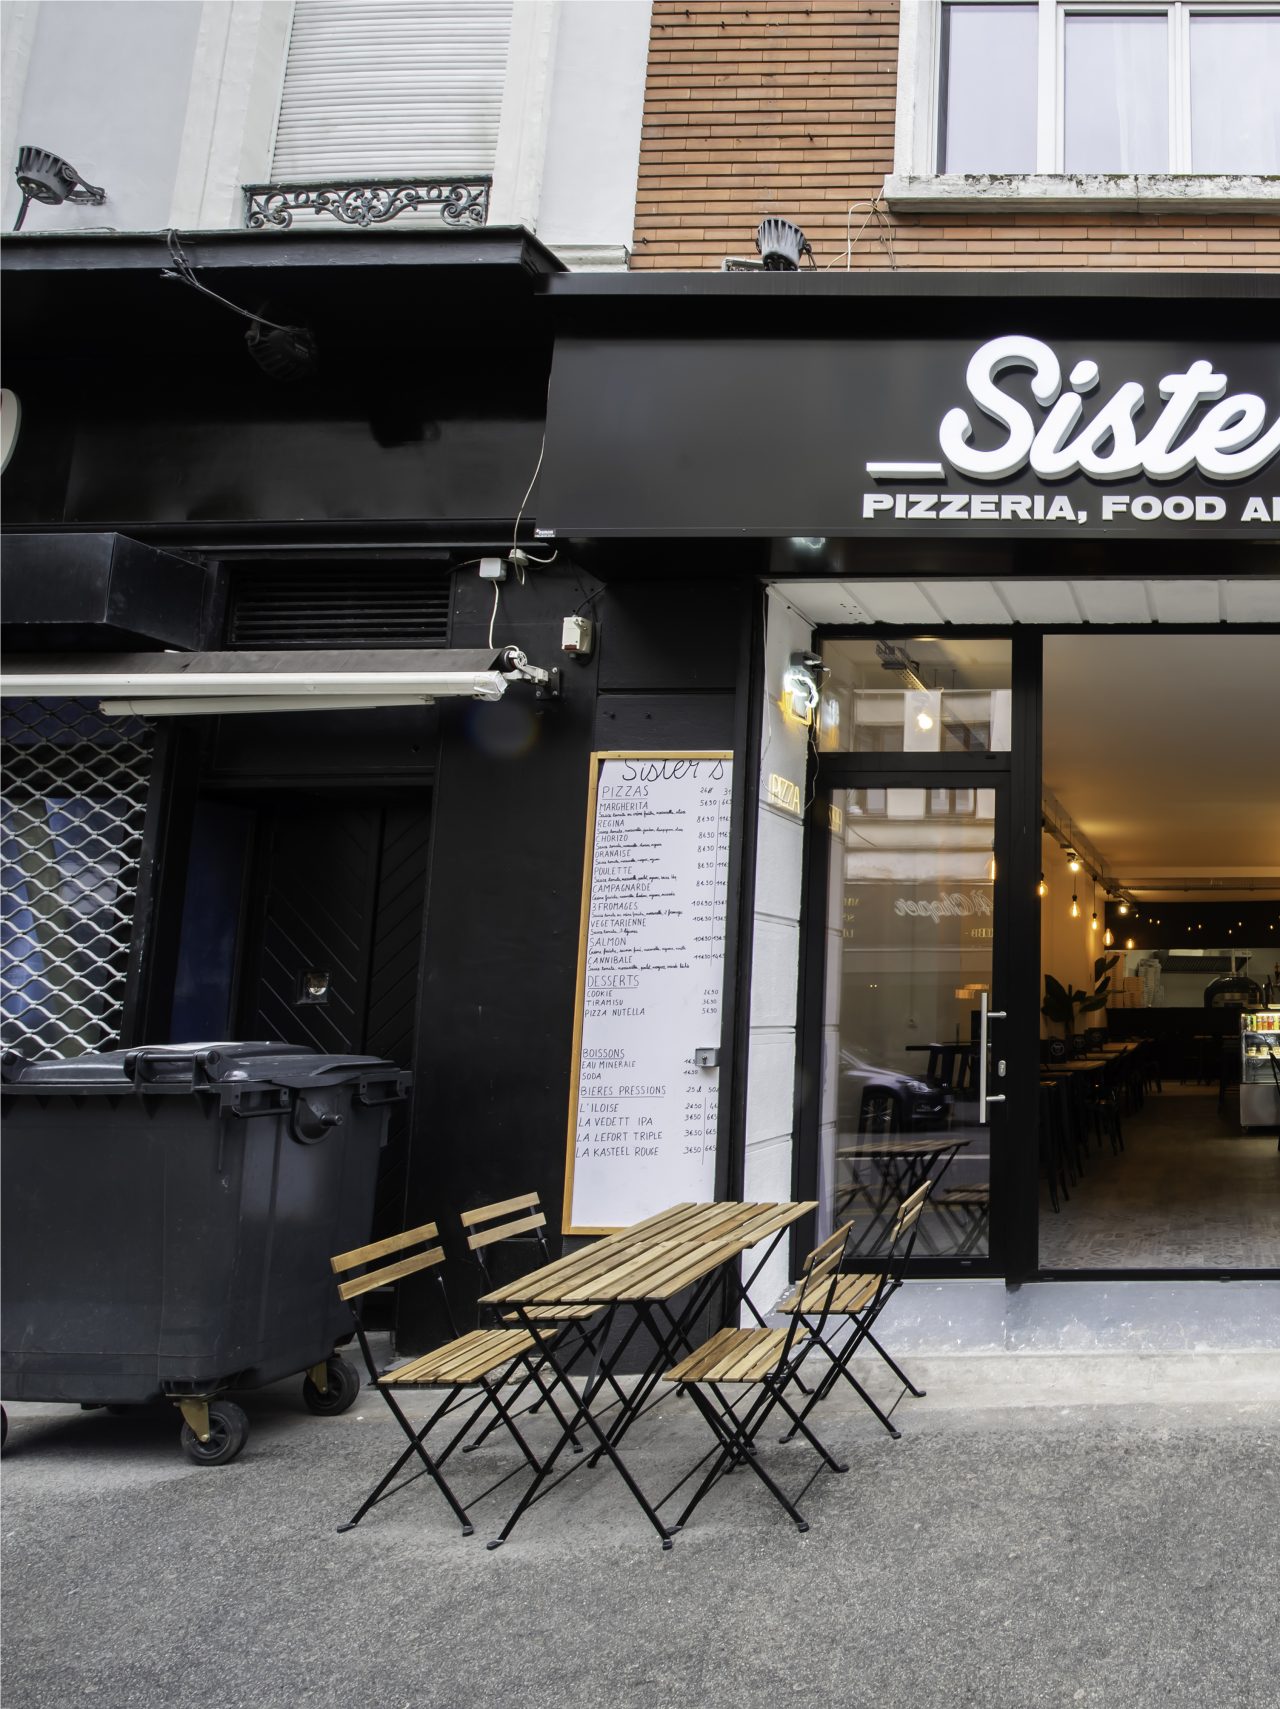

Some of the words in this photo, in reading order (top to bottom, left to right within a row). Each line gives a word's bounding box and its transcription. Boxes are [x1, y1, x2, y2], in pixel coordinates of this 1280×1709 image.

[863, 493, 1088, 525] PIZZERIA,
[1101, 494, 1228, 522] FOOD
[622, 759, 724, 782] Sisters
[602, 785, 649, 798] PIZZAS
[599, 801, 649, 811] MARGHERITA
[597, 819, 625, 828] REGINA
[596, 834, 629, 843] CHORIZO
[593, 882, 651, 893] CAMPAGNARDE
[588, 955, 633, 965] CANNIBALE
[587, 974, 640, 988] DESSERTS
[586, 990, 613, 998] COOKIE
[586, 999, 624, 1007] TIRAMISU
[584, 1009, 607, 1018] PIZZA
[612, 1007, 645, 1017] NUTELLA
[583, 1048, 625, 1059] BOISSONS
[582, 1060, 597, 1069] EAU
[598, 1060, 636, 1069] MINERALE
[582, 1072, 602, 1080] SODA
[581, 1086, 613, 1096] BIERES
[619, 1085, 667, 1095] PRESSIONS
[578, 1118, 591, 1127] LA
[595, 1117, 630, 1127] VEDETT
[638, 1116, 653, 1126] IPA
[577, 1133, 590, 1142] LA
[594, 1132, 628, 1142] LEFORT
[634, 1131, 663, 1140] TRIPLE
[576, 1148, 590, 1158] LA
[593, 1146, 630, 1157] KASTEEL
[634, 1146, 659, 1156] ROUGE
